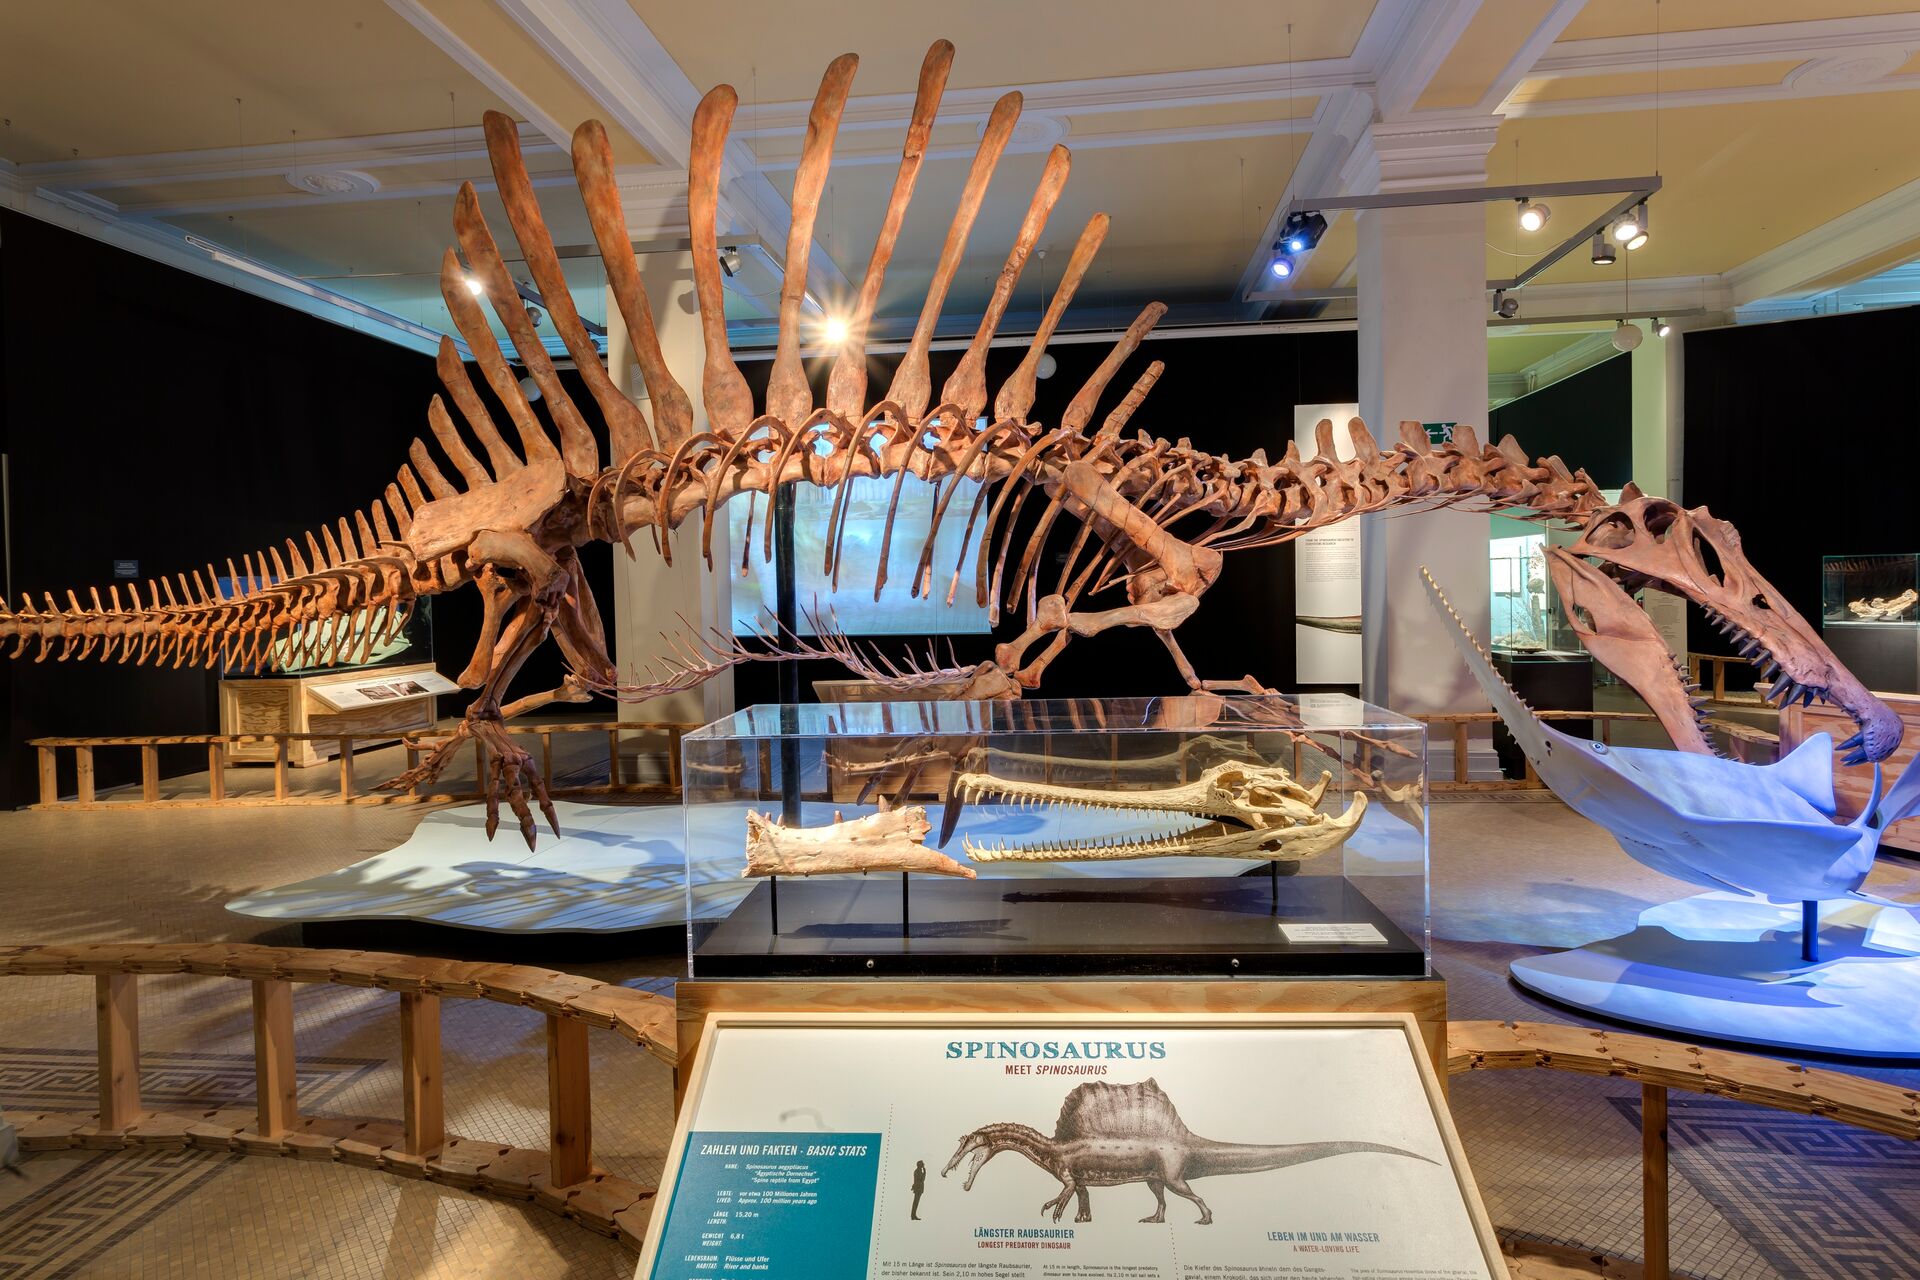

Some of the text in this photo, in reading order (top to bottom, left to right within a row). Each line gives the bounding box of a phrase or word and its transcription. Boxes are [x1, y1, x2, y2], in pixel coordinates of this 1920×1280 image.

[945, 1041, 1166, 1059] SPINOSAURUS
[1005, 1064, 1108, 1076] MEET SPINOSAURUS
[700, 1144, 868, 1157] ZAHLEN UND FAKTEN BASIC STATS
[974, 1226, 1075, 1239] LÄNGSTER RAUBSAURIER
[1267, 1231, 1380, 1243] LEBEN IM UND AM WASSER
